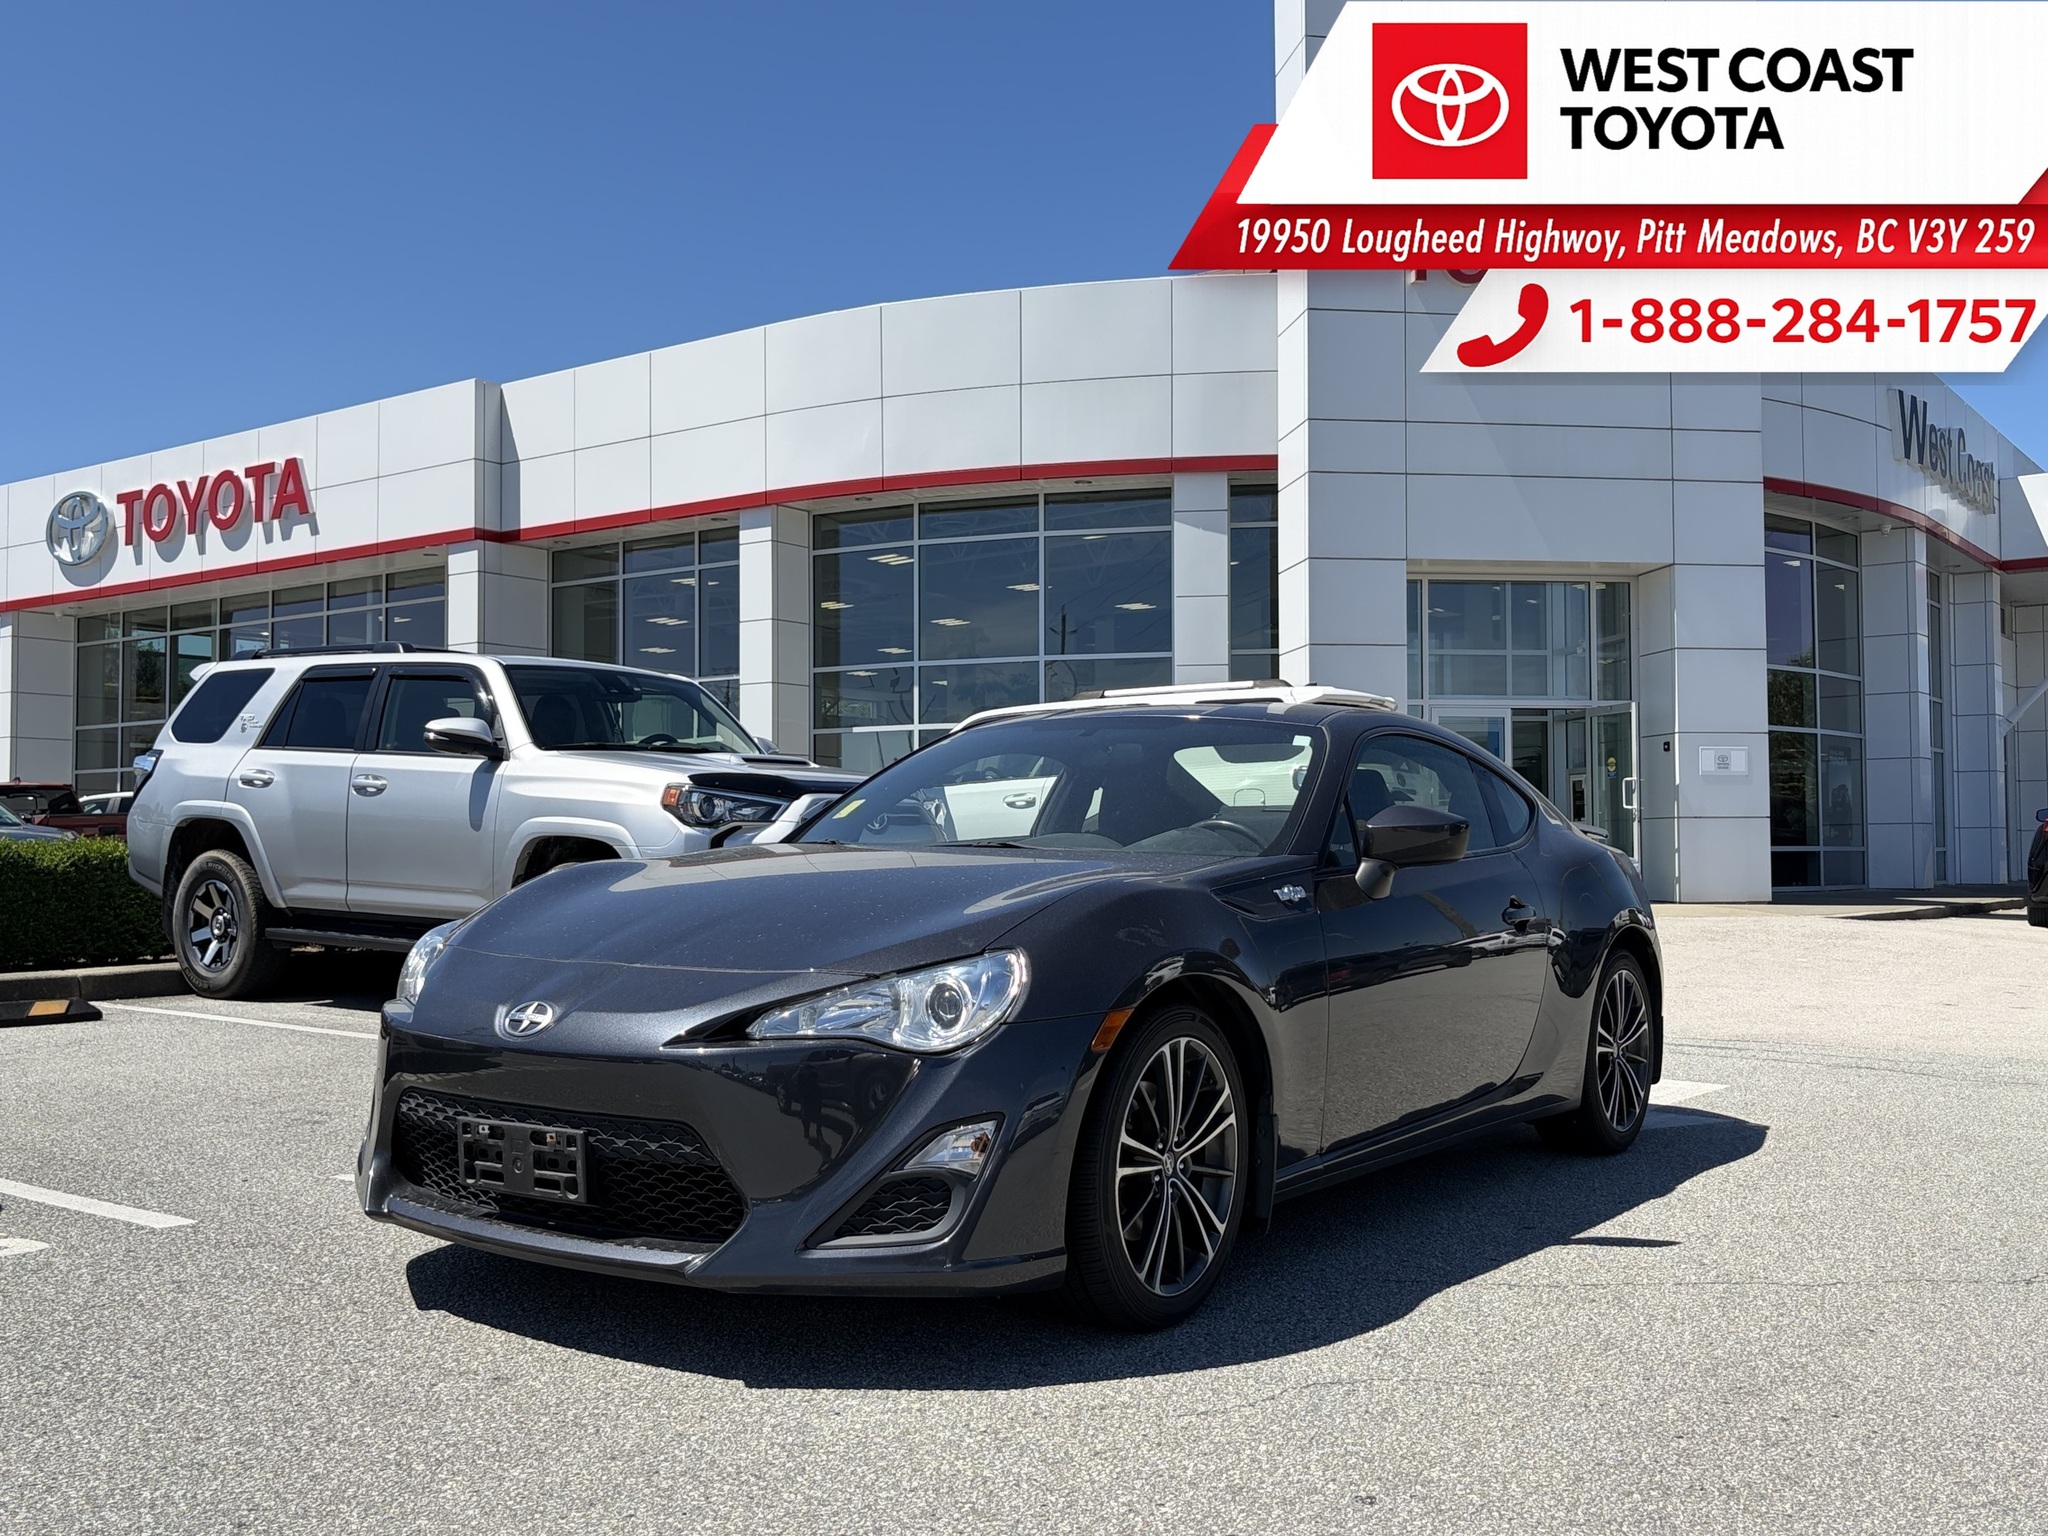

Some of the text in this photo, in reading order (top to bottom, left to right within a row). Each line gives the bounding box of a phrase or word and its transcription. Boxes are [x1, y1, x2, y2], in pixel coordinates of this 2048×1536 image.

[117, 457, 309, 546] TOYOTA
[1898, 389, 1995, 512] West Coast
